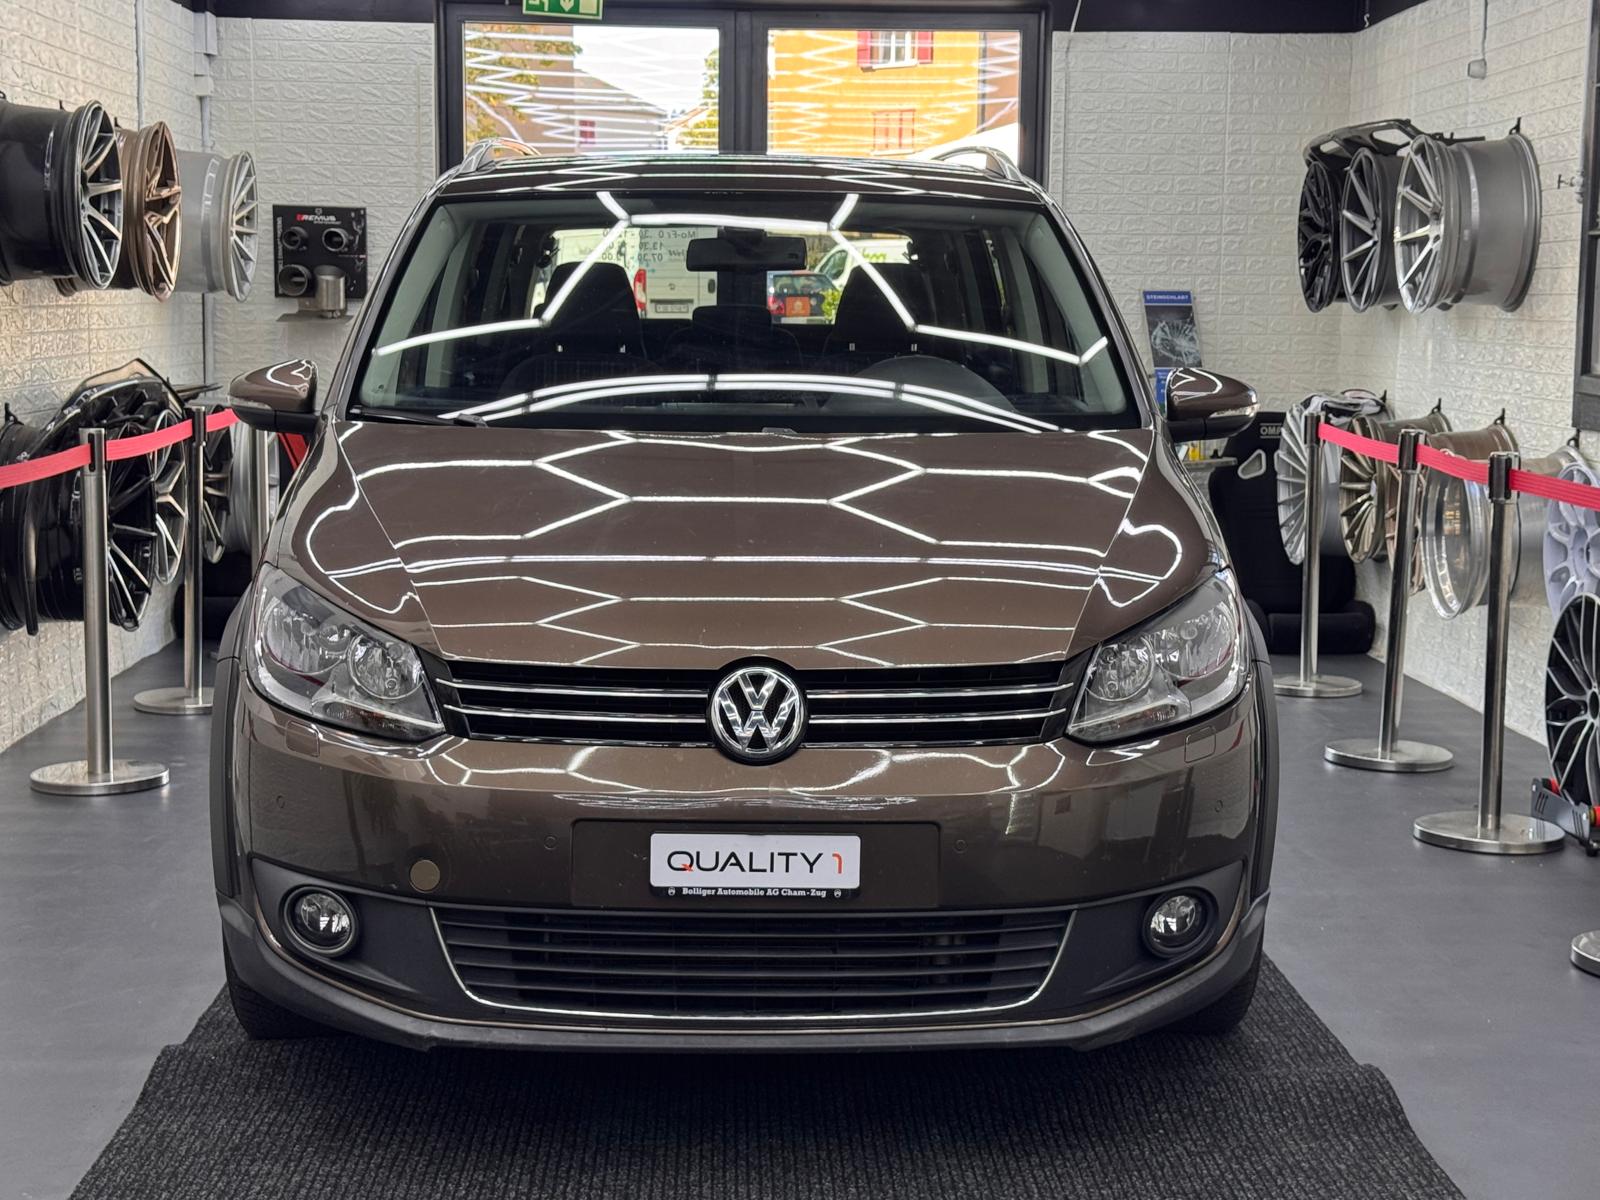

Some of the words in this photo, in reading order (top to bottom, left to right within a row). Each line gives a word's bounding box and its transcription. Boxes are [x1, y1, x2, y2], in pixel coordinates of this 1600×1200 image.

[667, 850, 824, 874] QUALITY
[831, 852, 843, 875] 1
[682, 887, 716, 897] Bolliger
[717, 887, 764, 896] Automobile
[766, 888, 780, 896] AG
[781, 888, 827, 898] Cham-Zug
